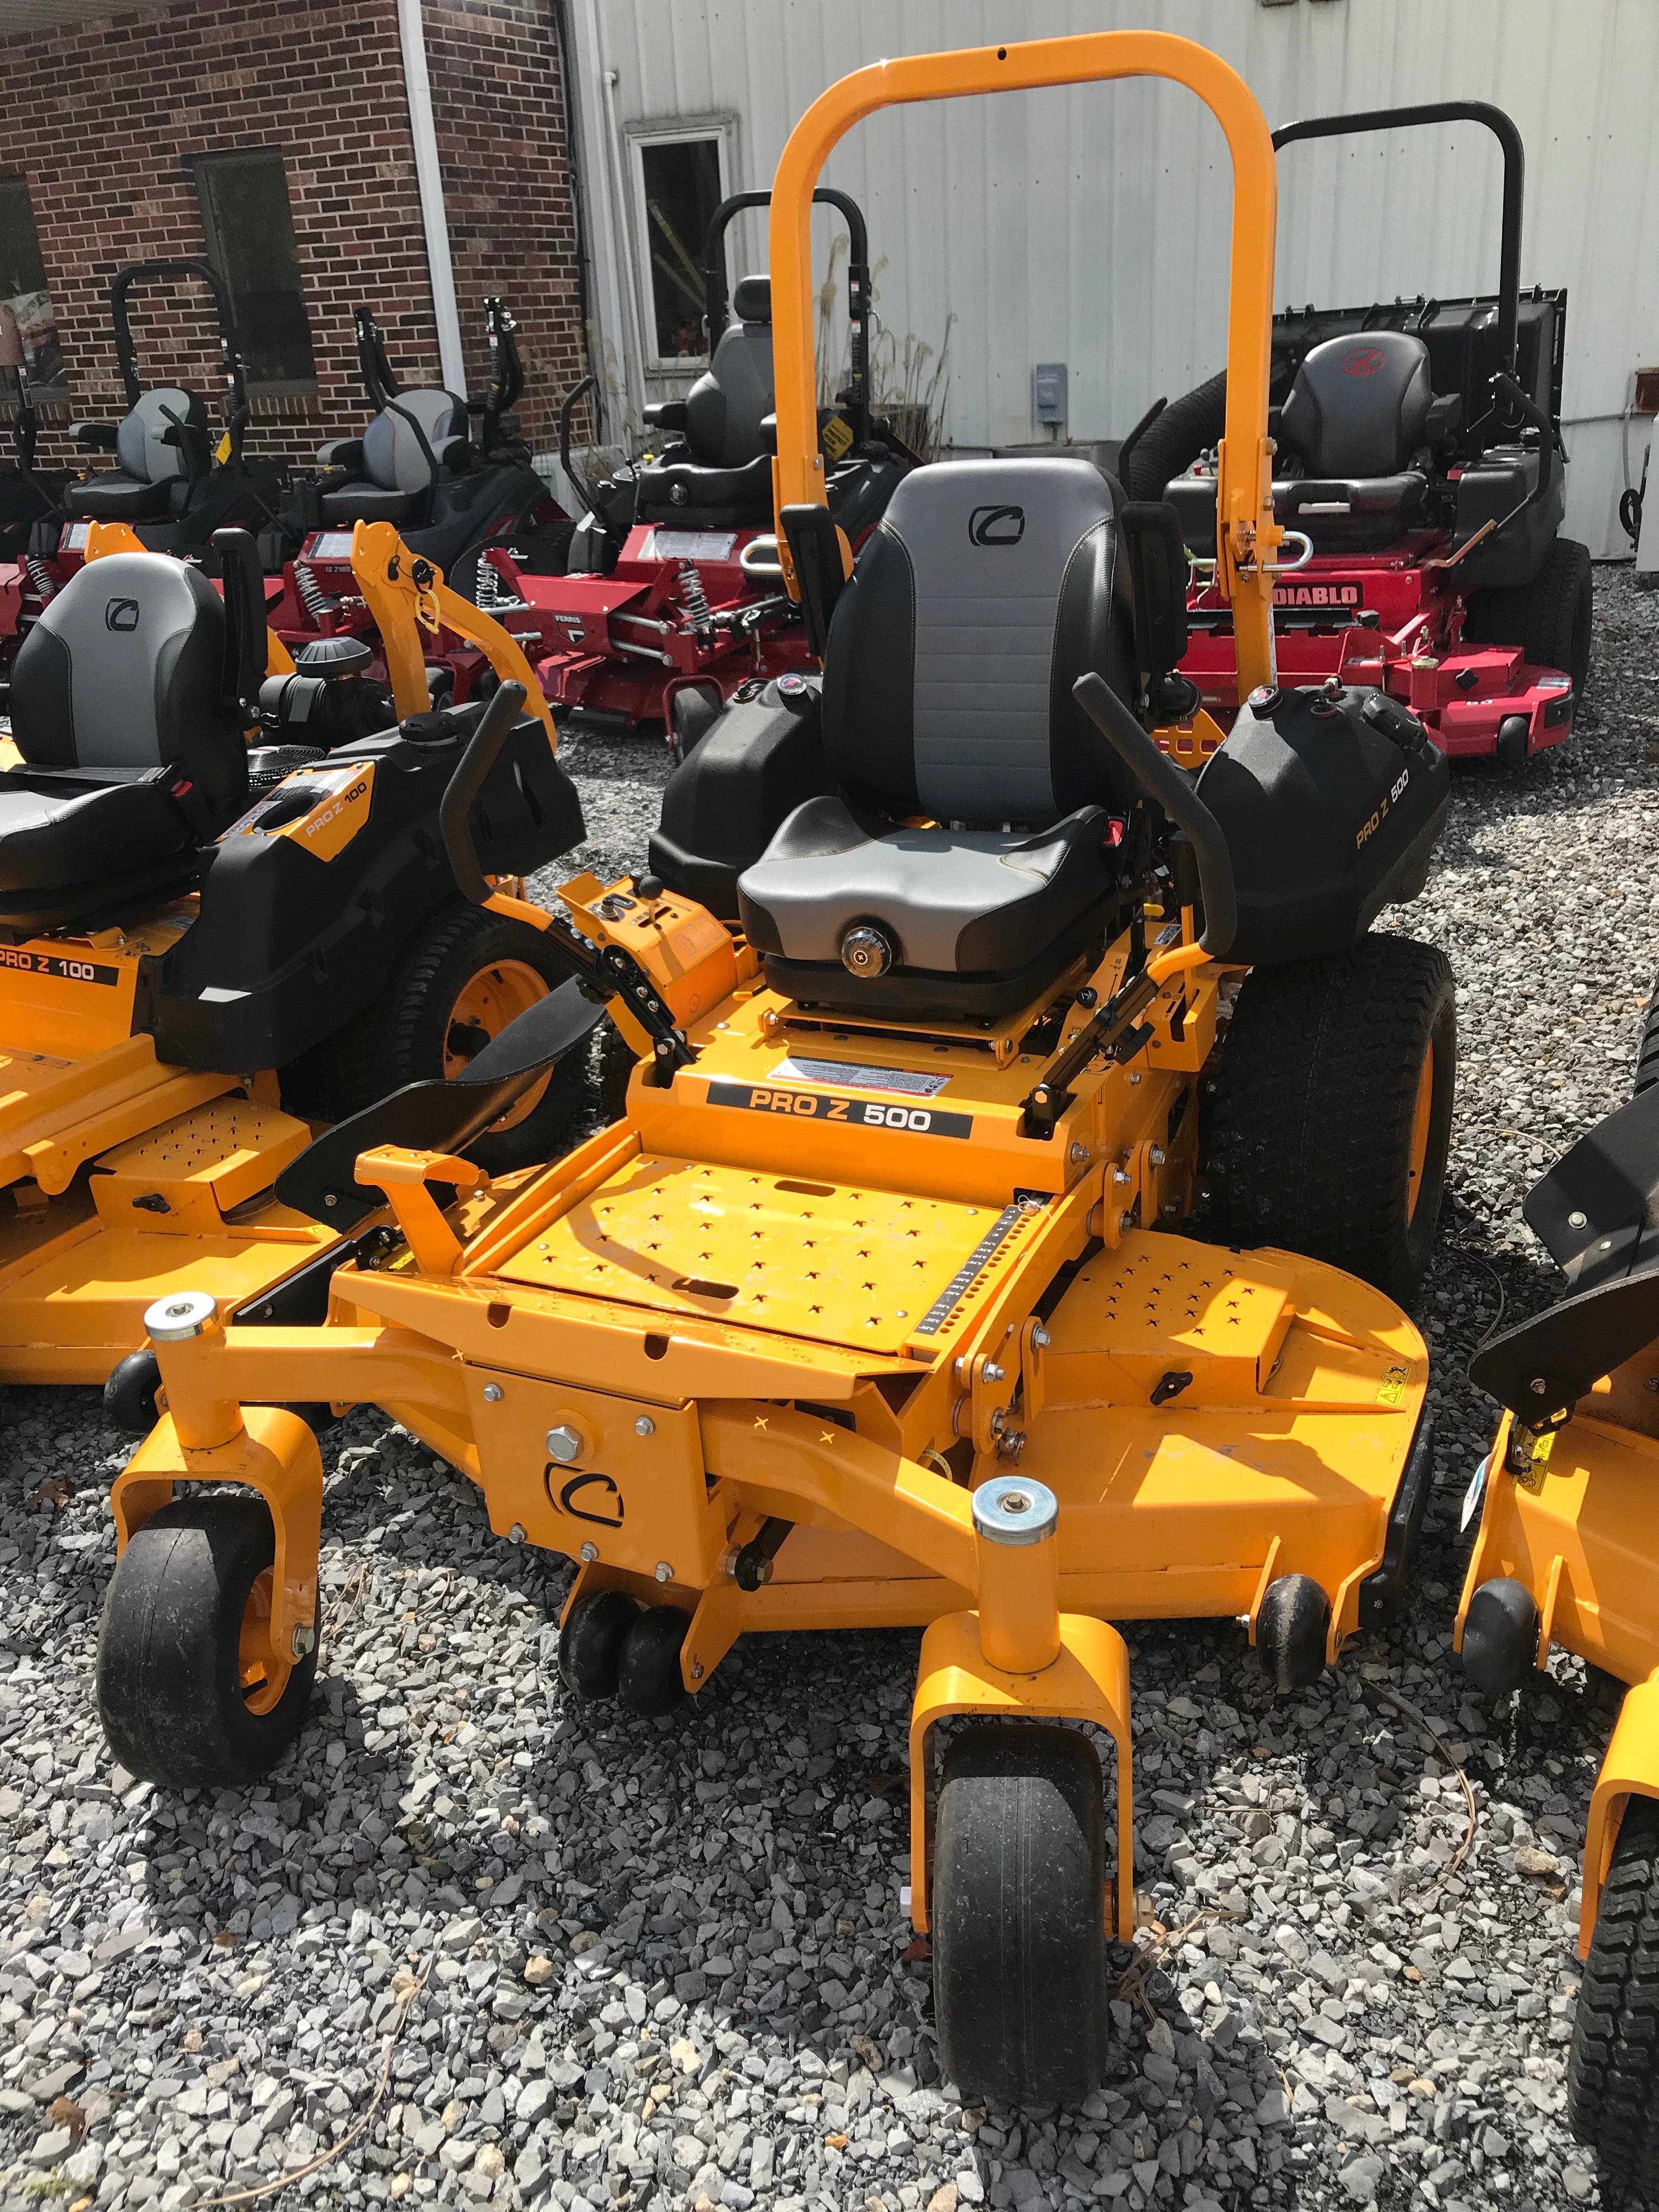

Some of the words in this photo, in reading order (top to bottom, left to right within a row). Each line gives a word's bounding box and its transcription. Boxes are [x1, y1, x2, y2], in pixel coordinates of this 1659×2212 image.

[1272, 586, 1357, 605] DIABLO
[555, 615, 581, 624] FERRIS
[305, 810, 334, 837] PRO
[332, 802, 343, 815] Z
[344, 782, 367, 803] 100
[1356, 811, 1379, 850] PRO
[1380, 798, 1389, 819] Z
[1391, 768, 1409, 803] 500
[37, 956, 49, 973] Z
[59, 961, 94, 980] 100
[749, 1089, 817, 1115] PRO
[827, 1099, 850, 1120] Z
[864, 1104, 932, 1131] 500
